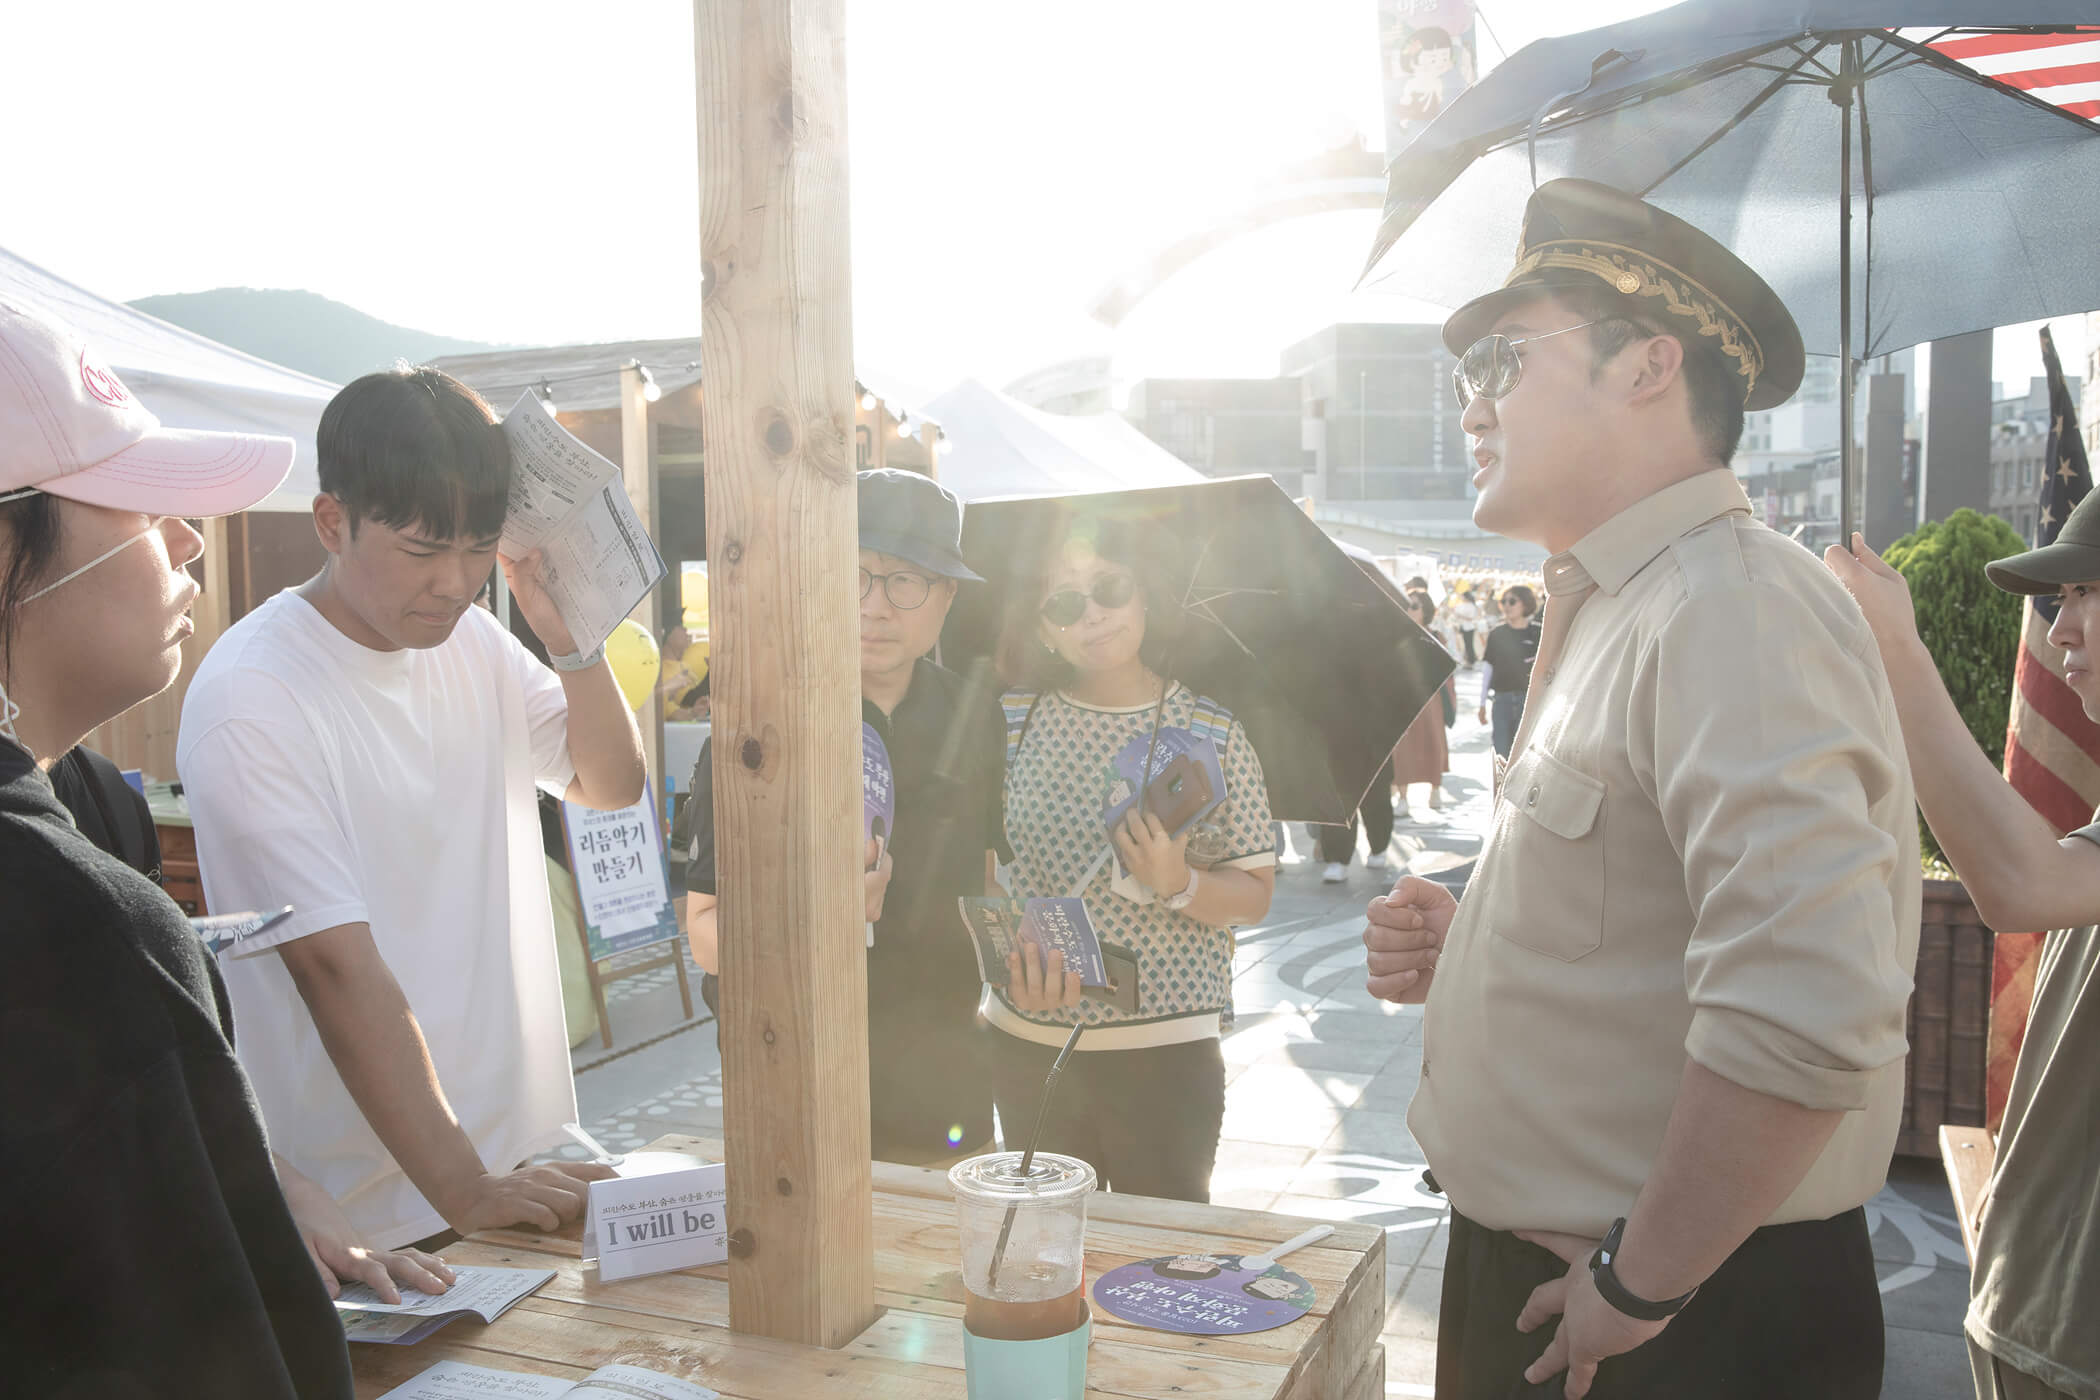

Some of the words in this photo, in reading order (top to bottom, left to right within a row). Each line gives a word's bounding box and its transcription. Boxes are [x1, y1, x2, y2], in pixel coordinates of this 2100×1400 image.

[579, 821, 647, 855] 리듬악기
[592, 851, 644, 884] 만들기
[608, 1222, 618, 1245] I
[626, 1212, 675, 1242] will
[683, 1209, 715, 1234] be
[1105, 1286, 1150, 1302] 부산
[1130, 1280, 1177, 1296] 야행
[1178, 1291, 1248, 1316] 문화재
[1157, 1297, 1243, 1328] 피란수도
